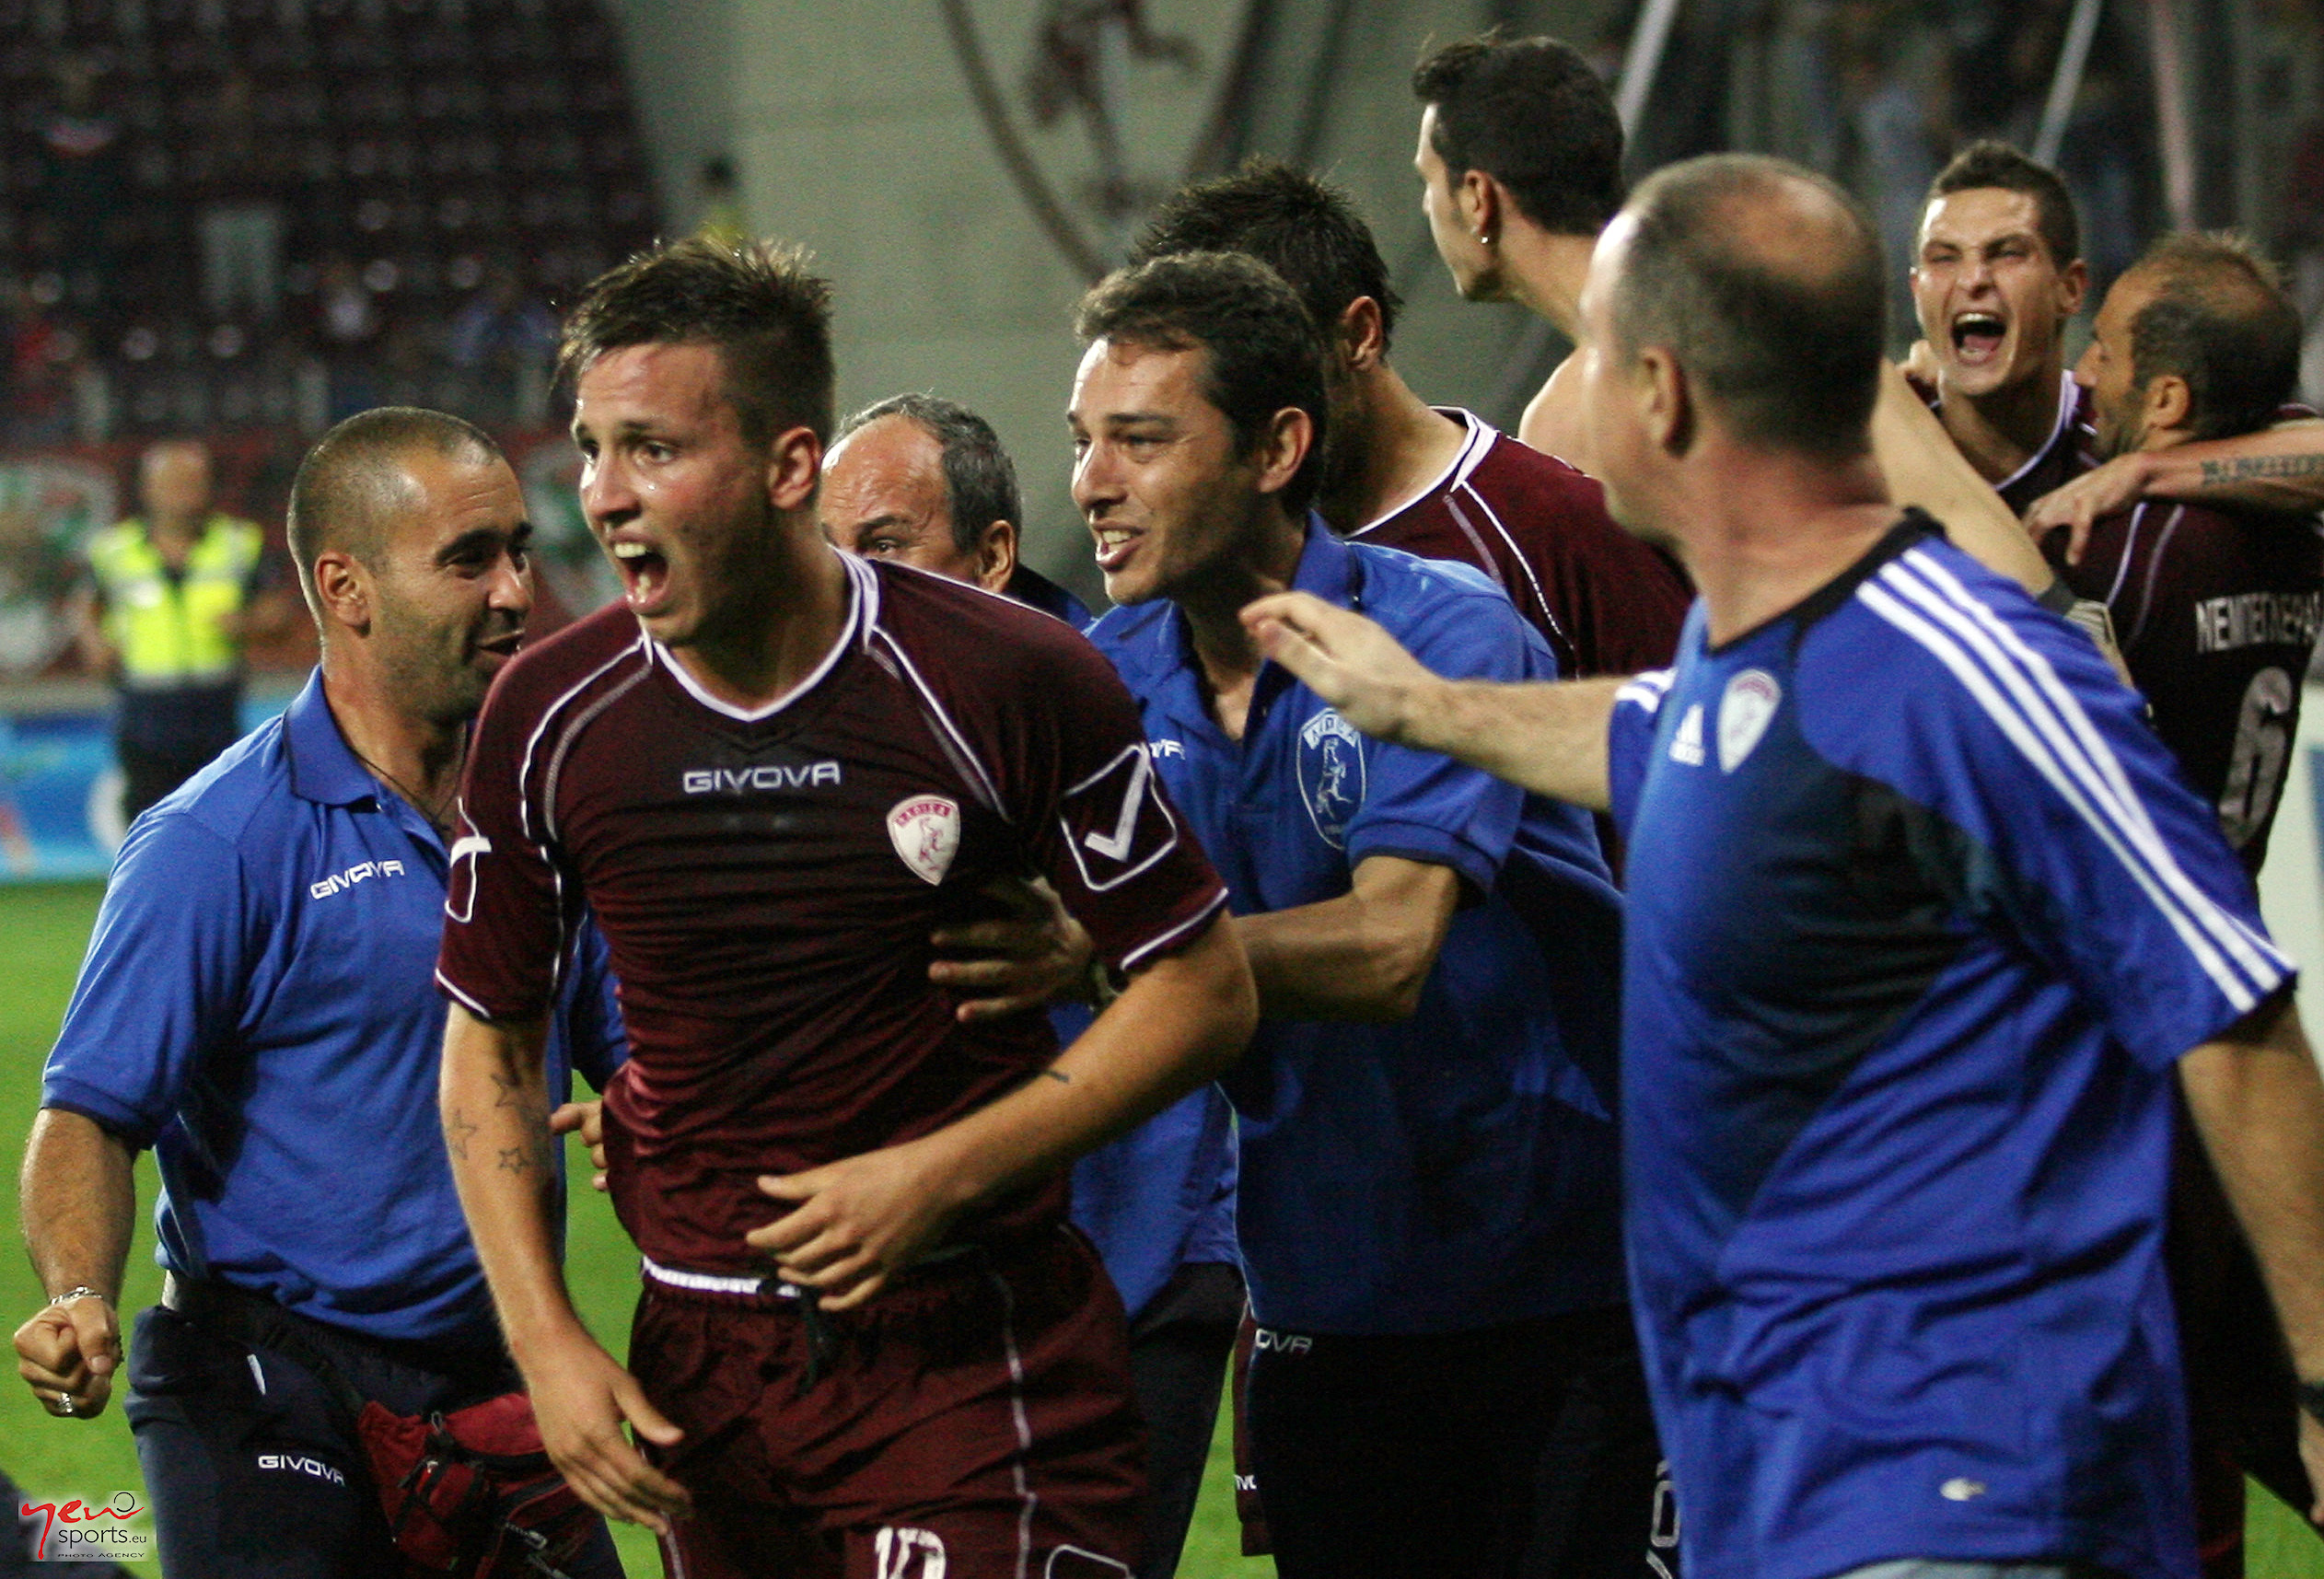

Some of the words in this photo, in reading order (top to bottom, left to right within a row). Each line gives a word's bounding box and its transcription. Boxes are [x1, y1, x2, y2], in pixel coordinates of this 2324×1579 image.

[2218, 666, 2293, 850] 6
[682, 760, 842, 794] GIVOVA
[309, 859, 405, 900] GIVOVA
[1254, 1328, 1313, 1355] OVA
[258, 1455, 346, 1488] GIVOVA
